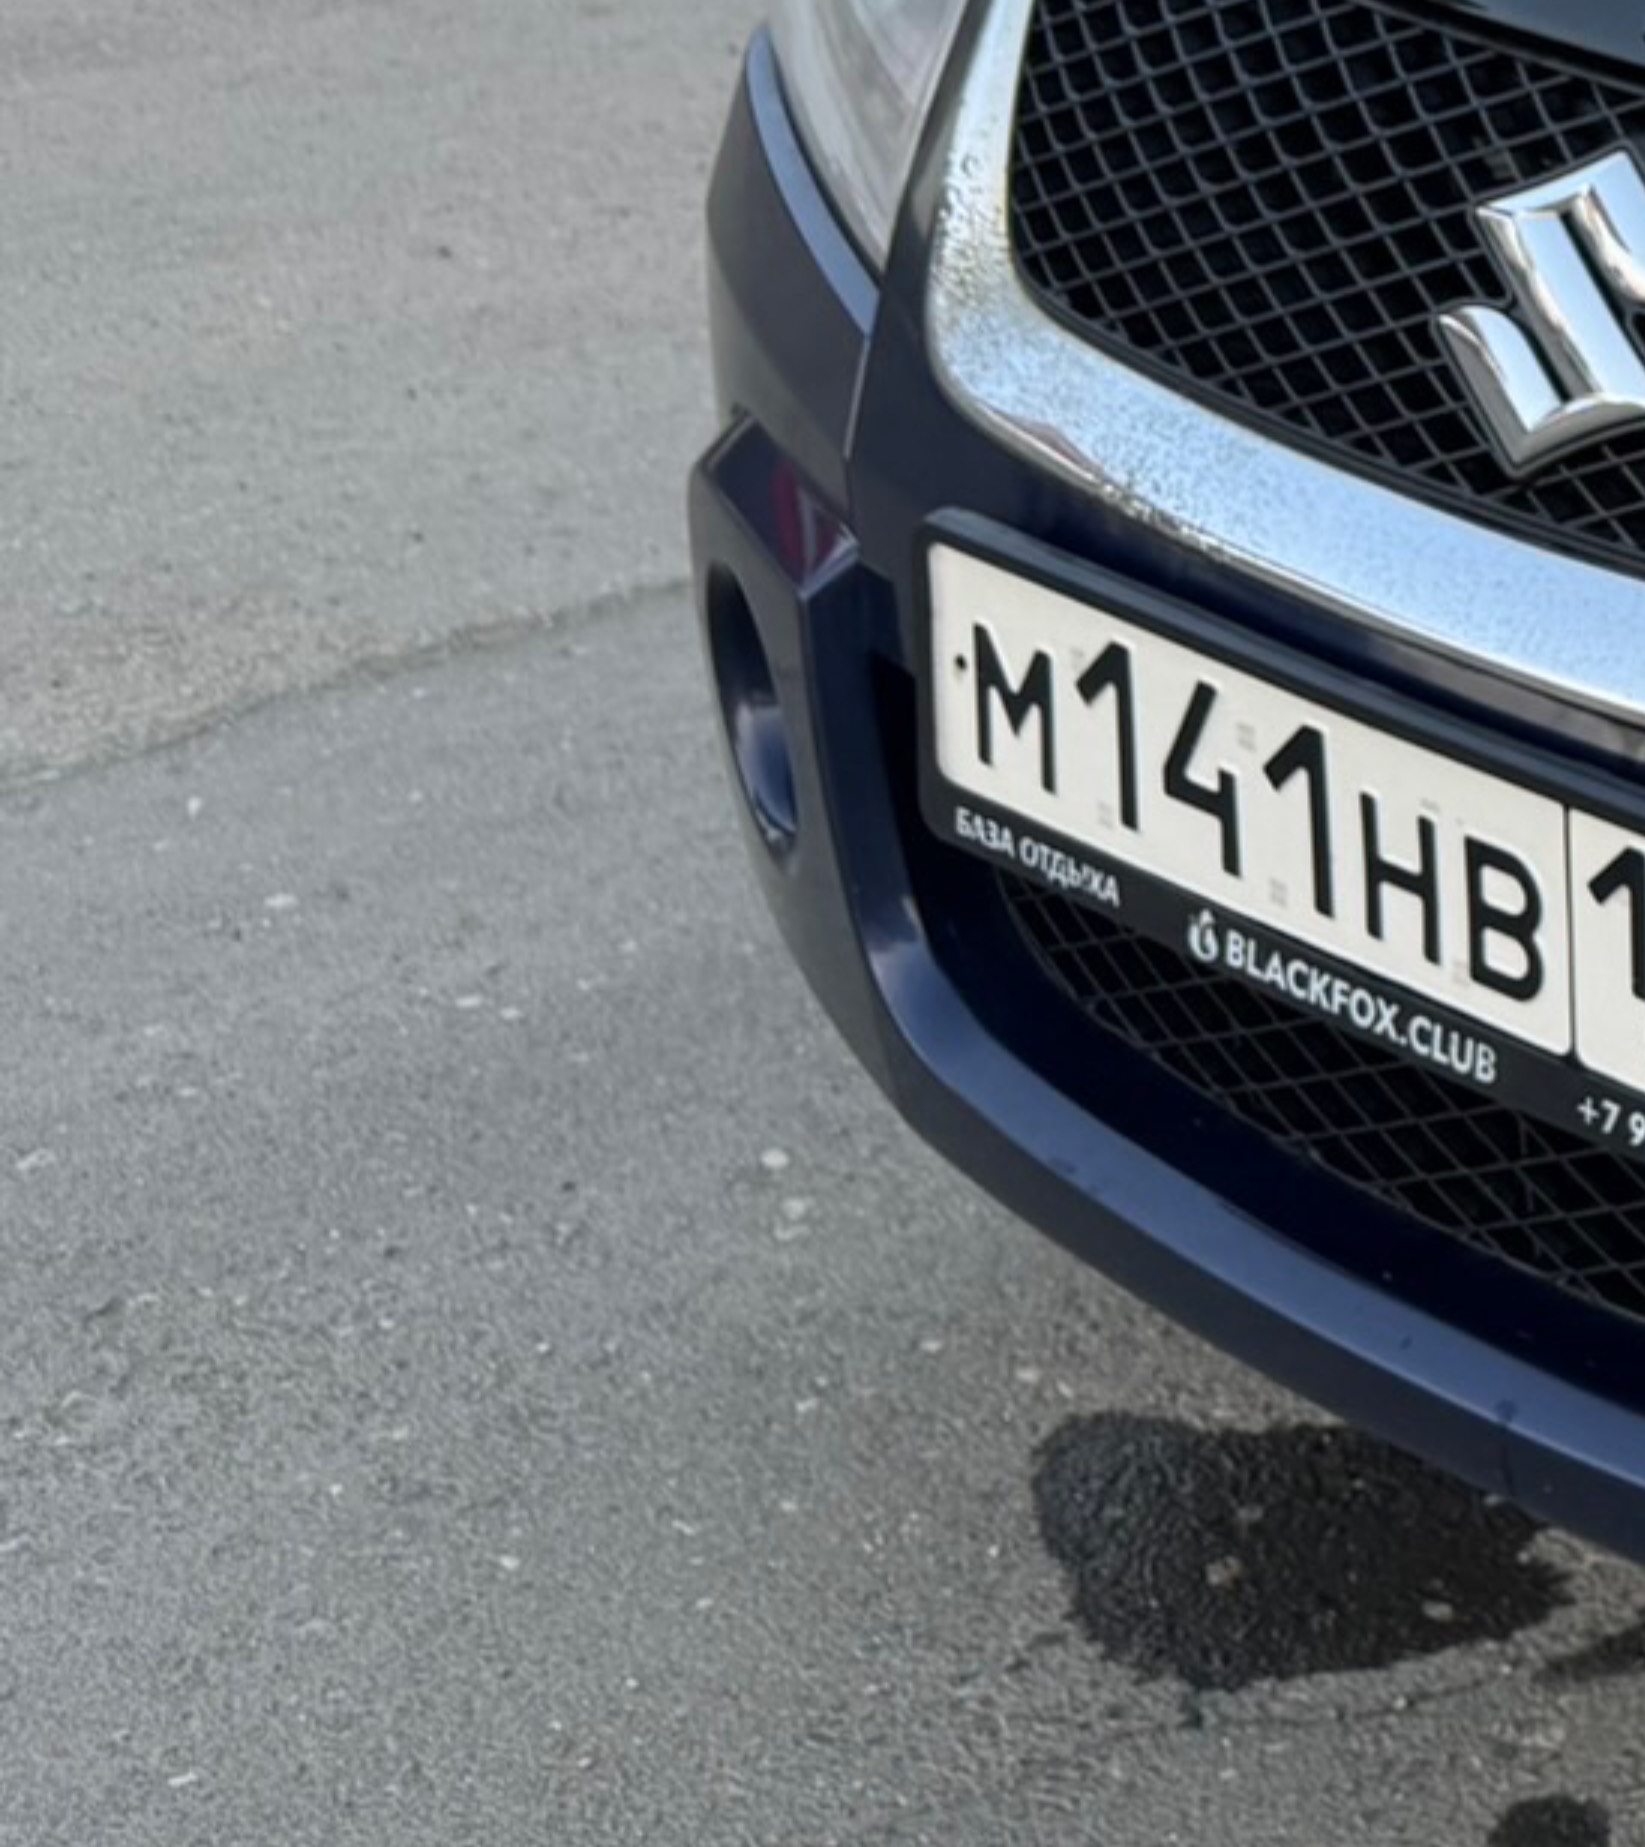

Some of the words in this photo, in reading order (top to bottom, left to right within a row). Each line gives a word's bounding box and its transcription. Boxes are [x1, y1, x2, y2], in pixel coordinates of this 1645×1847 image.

[954, 806, 1016, 860] БАЗА
[1018, 836, 1122, 908] ОТДЫХА
[1225, 929, 1498, 1084] BLACKFOX.CLUB
[1576, 1096, 1622, 1135] +7
